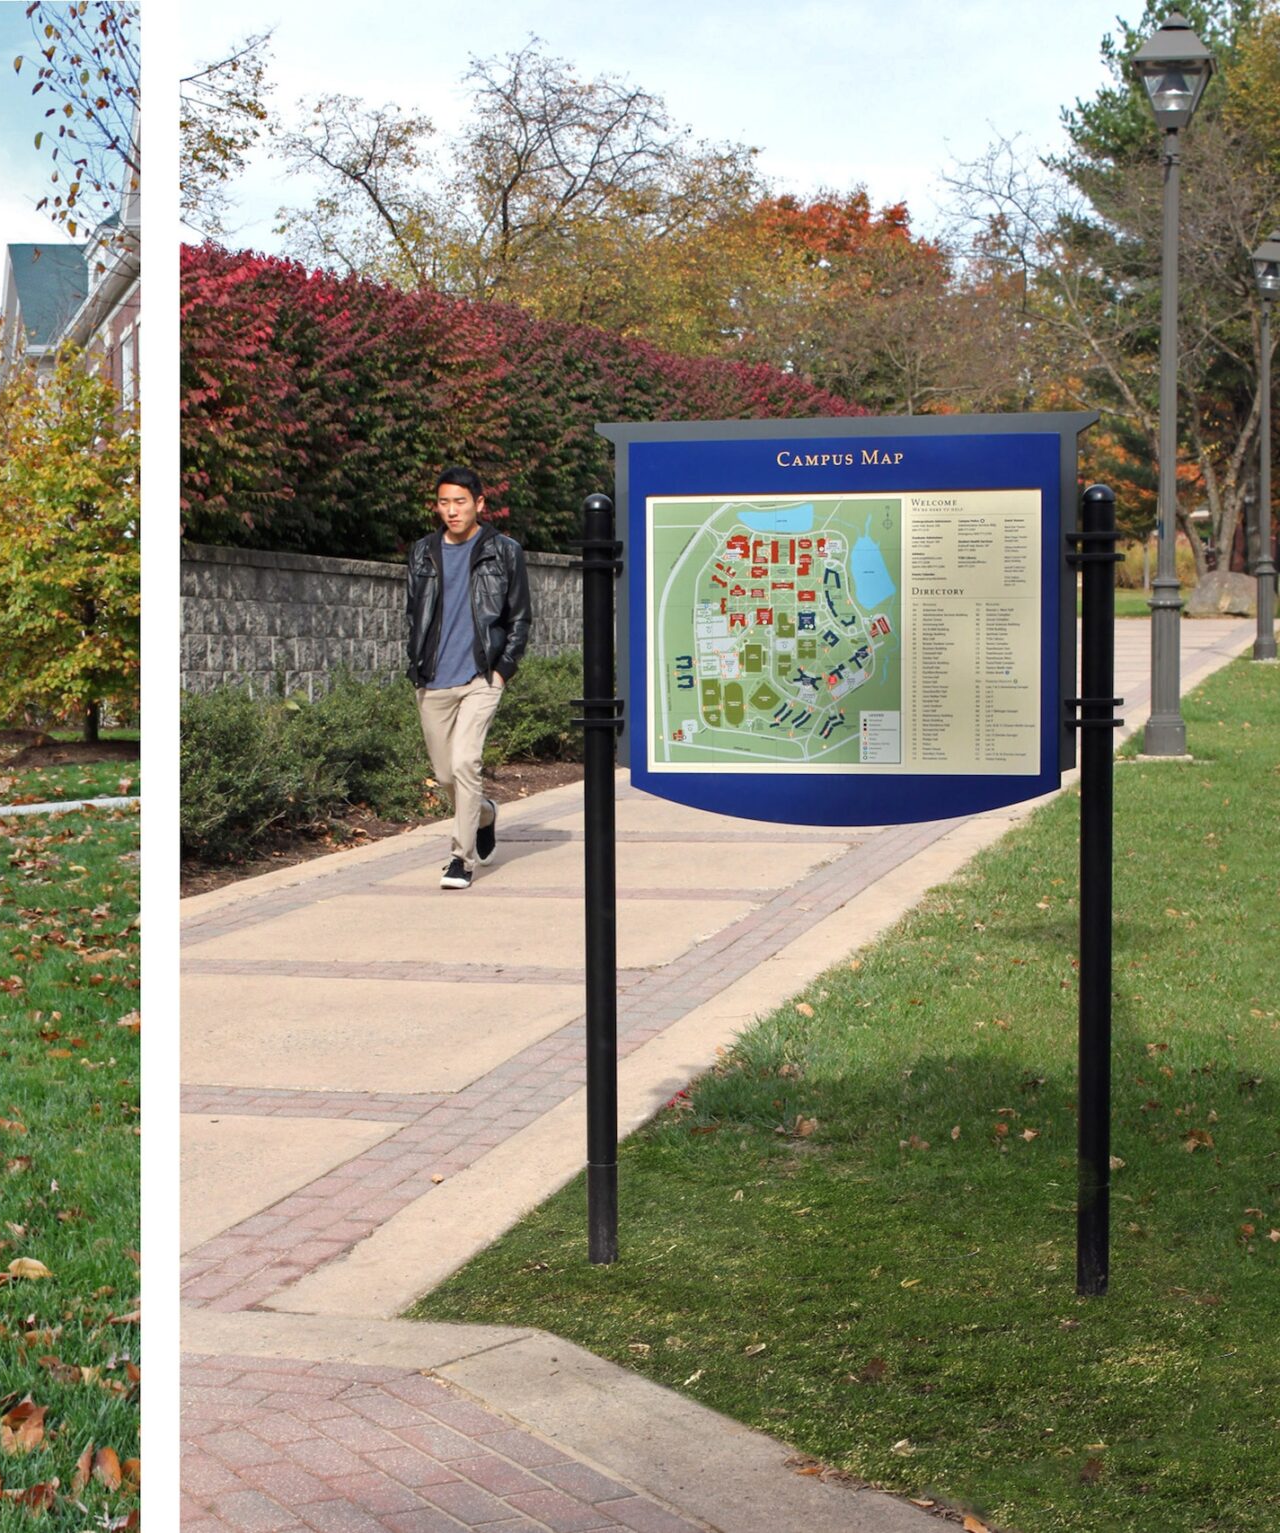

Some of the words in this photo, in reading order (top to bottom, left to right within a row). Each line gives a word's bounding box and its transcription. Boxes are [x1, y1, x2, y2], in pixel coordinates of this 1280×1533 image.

[776, 451, 855, 468] CAMPUS
[860, 449, 904, 467] MAP
[910, 498, 959, 507] WELCOME
[911, 586, 965, 596] DIRECTORY
